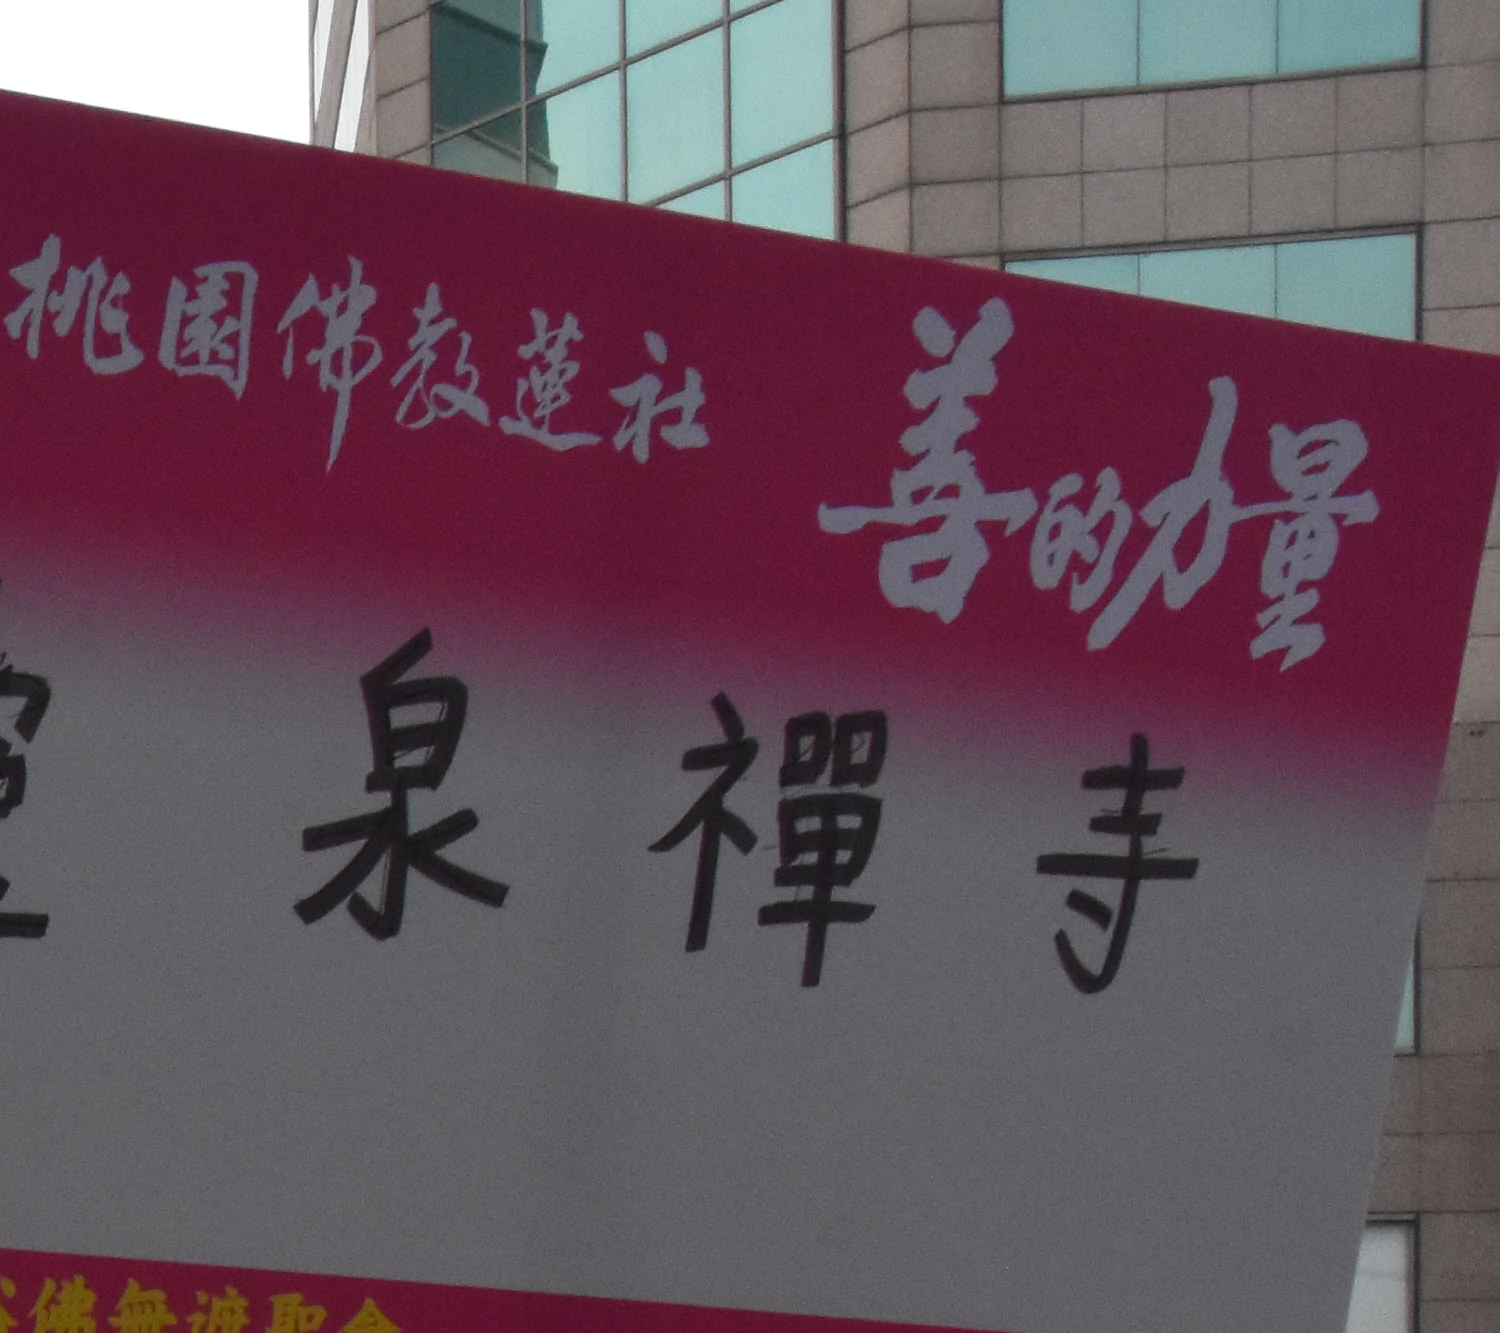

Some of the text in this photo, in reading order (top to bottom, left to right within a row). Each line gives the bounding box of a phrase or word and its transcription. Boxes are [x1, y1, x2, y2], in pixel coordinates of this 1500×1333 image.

[3, 232, 711, 471] 桃園佛教蓮社
[816, 298, 1379, 670] 善的力量
